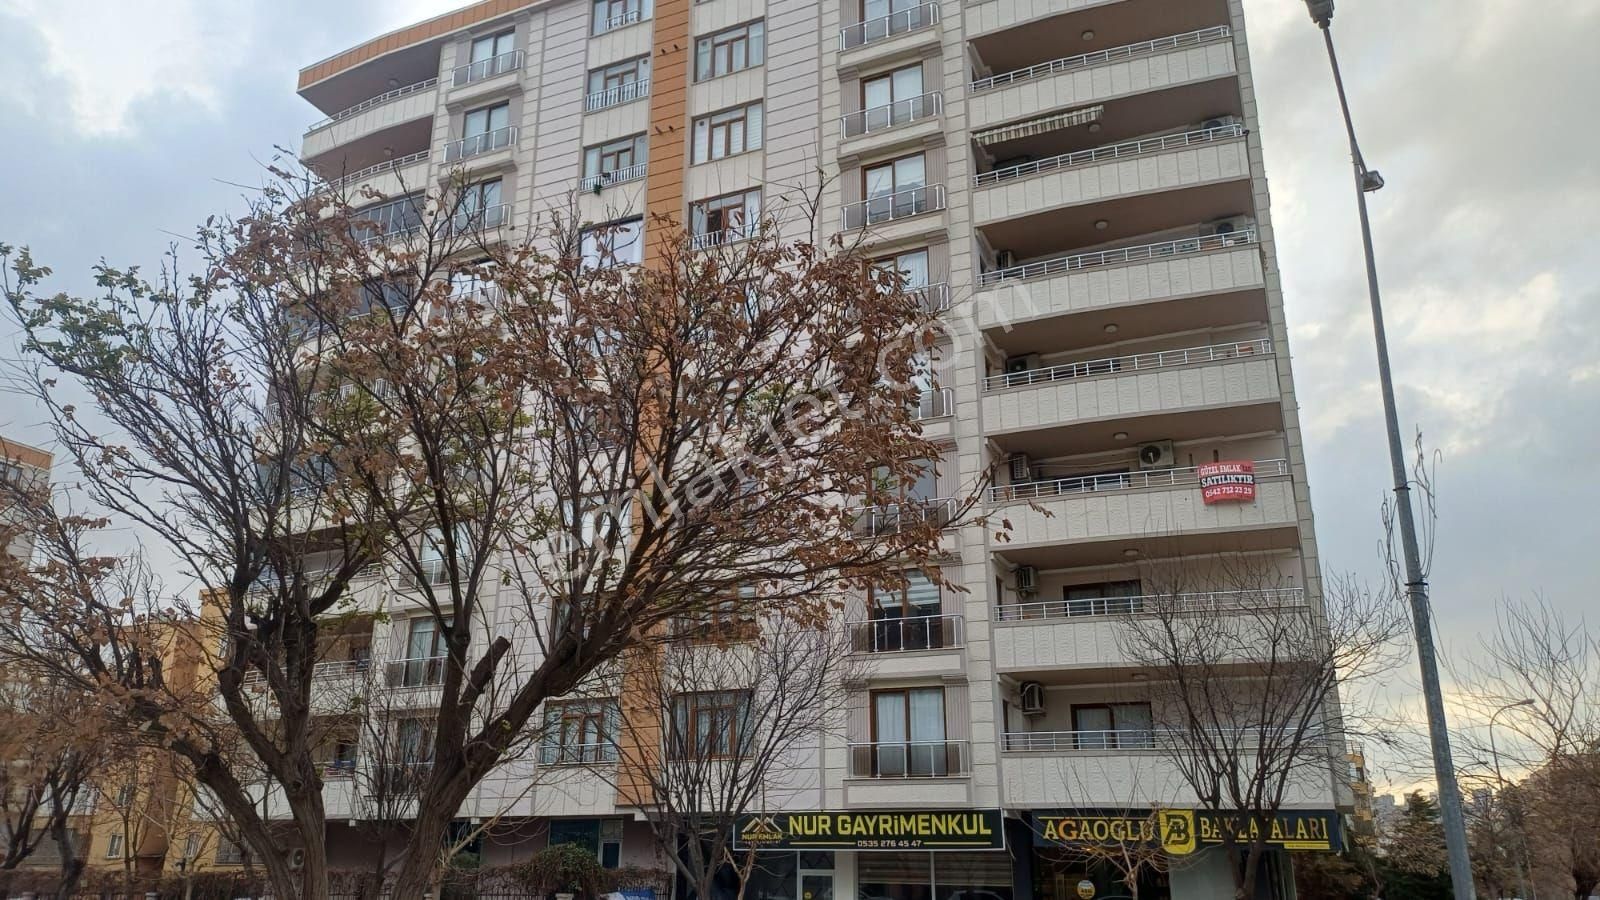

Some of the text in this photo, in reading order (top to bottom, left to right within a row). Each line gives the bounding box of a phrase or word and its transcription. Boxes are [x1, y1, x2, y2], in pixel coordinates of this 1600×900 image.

[1219, 464, 1241, 473] EMLAK
[1201, 474, 1254, 488] SATILIKTIR
[789, 815, 832, 835] NUR
[1199, 816, 1329, 839] BAKLAALARI
